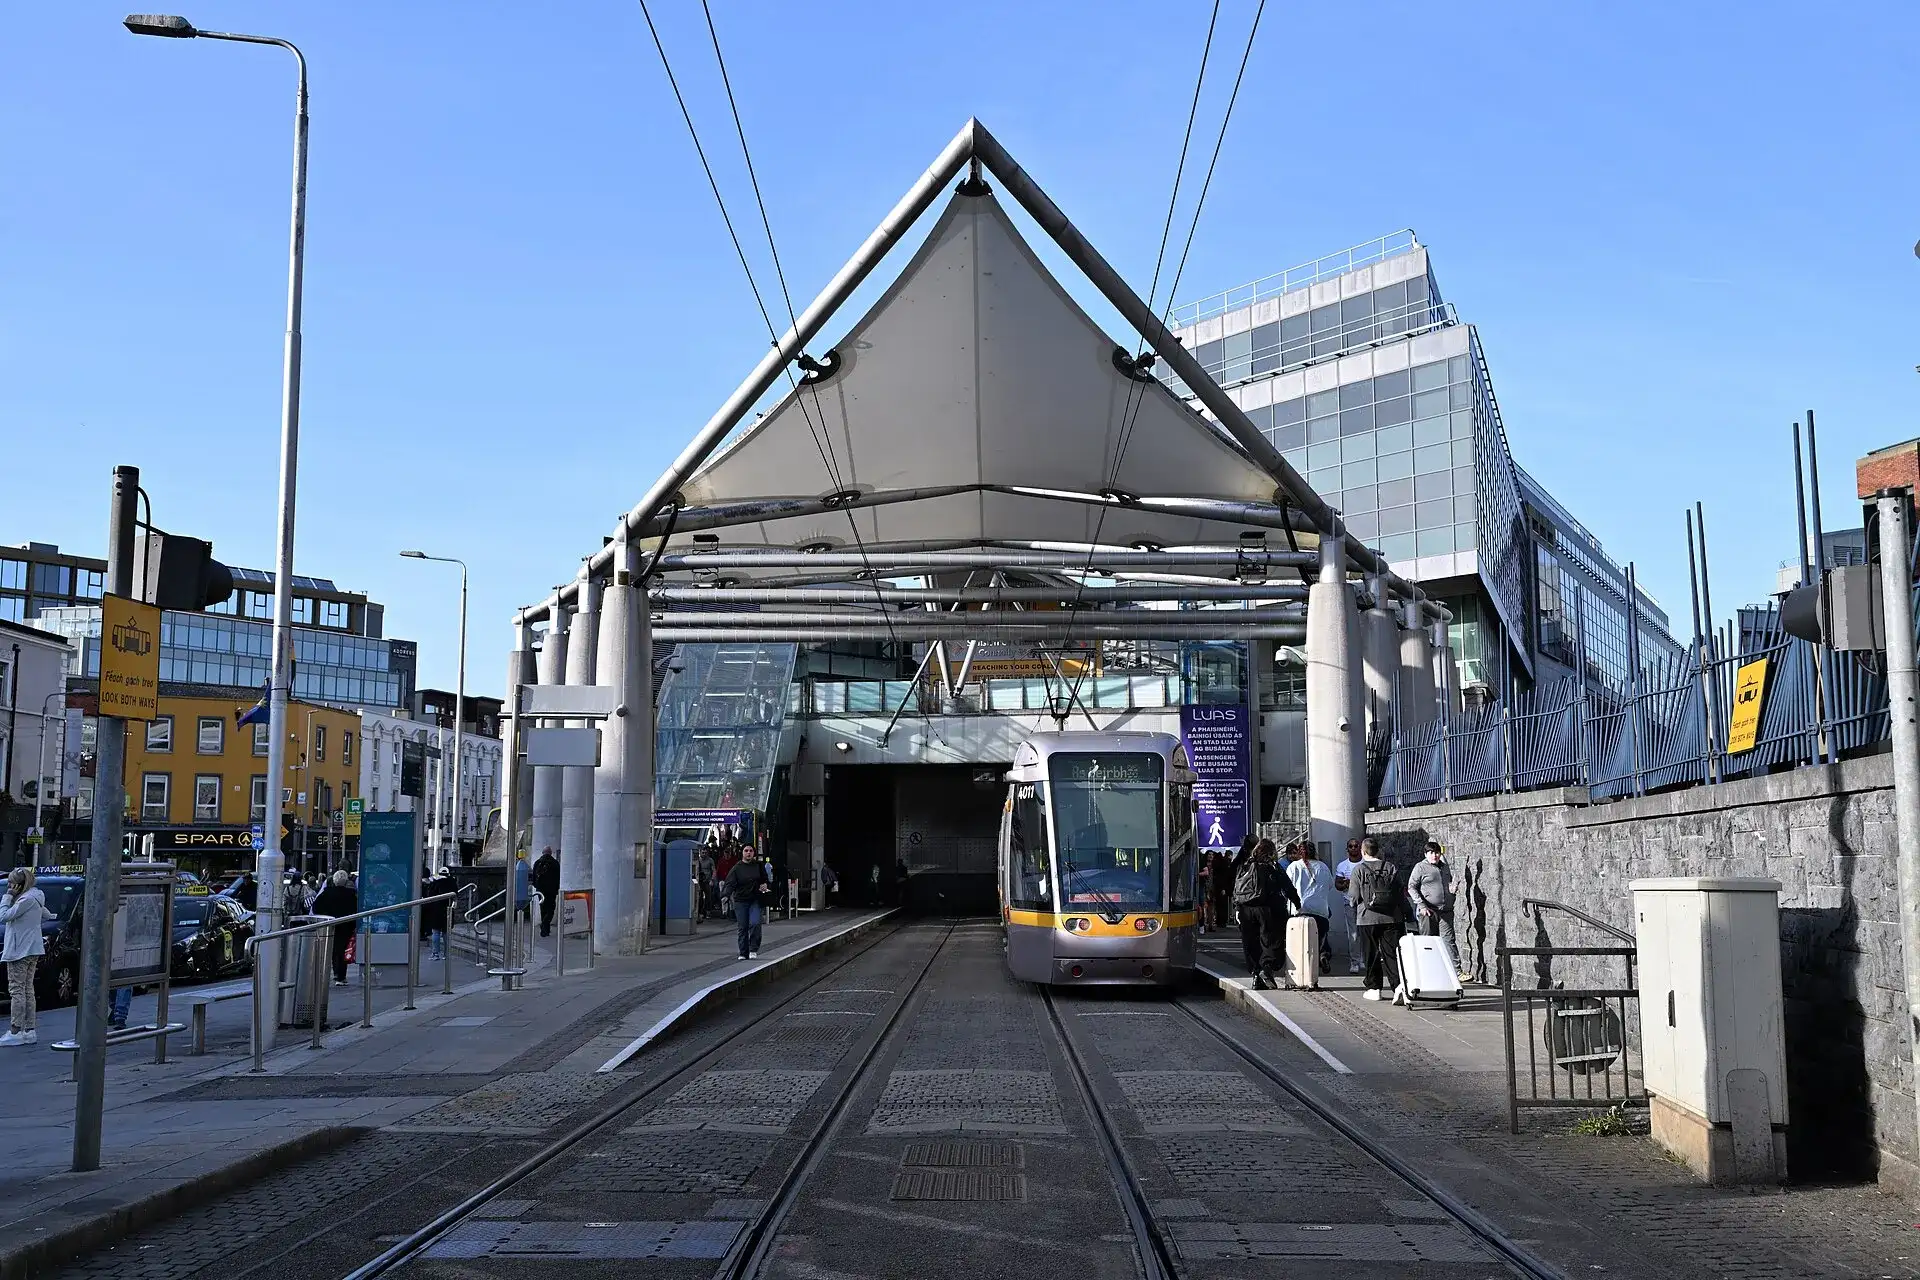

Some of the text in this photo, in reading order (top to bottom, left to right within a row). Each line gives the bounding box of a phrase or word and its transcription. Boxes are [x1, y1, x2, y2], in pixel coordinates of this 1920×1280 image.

[104, 669, 124, 684] Féach
[141, 676, 154, 688] treo
[101, 691, 155, 709] LOOK BOTH WAYS
[1192, 708, 1237, 721] LUAS
[1018, 785, 1035, 800] 4011
[174, 834, 234, 844] SPAR
[317, 835, 339, 845] SPR
